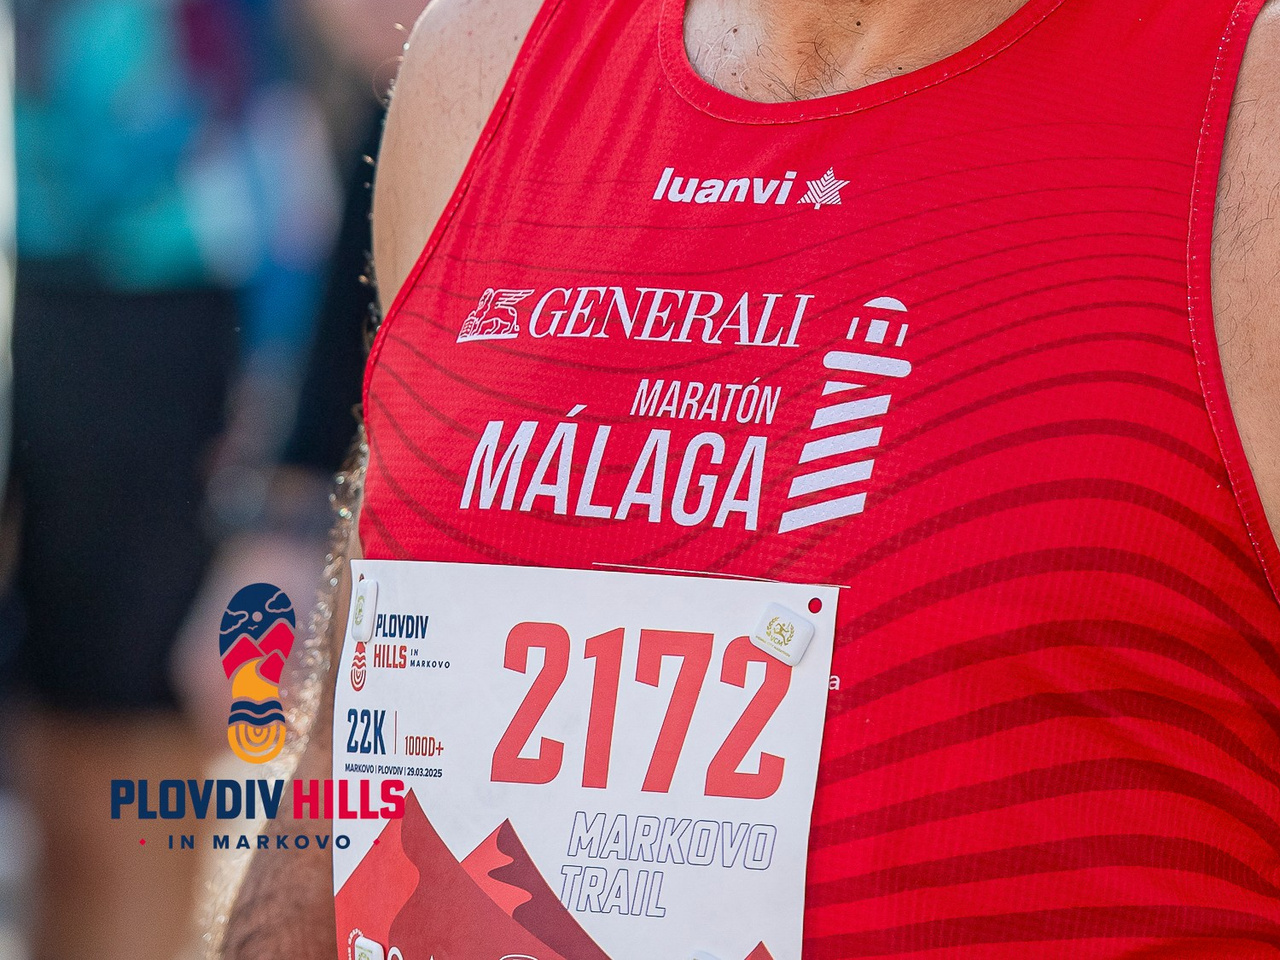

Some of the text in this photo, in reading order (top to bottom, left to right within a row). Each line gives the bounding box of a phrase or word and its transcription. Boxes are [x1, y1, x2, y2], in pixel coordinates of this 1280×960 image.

[653, 167, 797, 205] luanvi
[529, 286, 815, 347] GENERALI
[630, 377, 782, 425] MARATÓN
[459, 404, 767, 531] MÁLAGA
[375, 613, 429, 639] PLOVDIV
[373, 644, 407, 669] HILLS
[410, 648, 419, 656] IN
[410, 659, 451, 669] MARKOVO
[346, 708, 444, 757] 22K 1000D+
[490, 621, 793, 800] 2172
[344, 763, 443, 778] MARKOVO PLOVDIV 29.03.2025
[567, 811, 777, 871] MARKOVO
[560, 864, 666, 918] TRAIL
